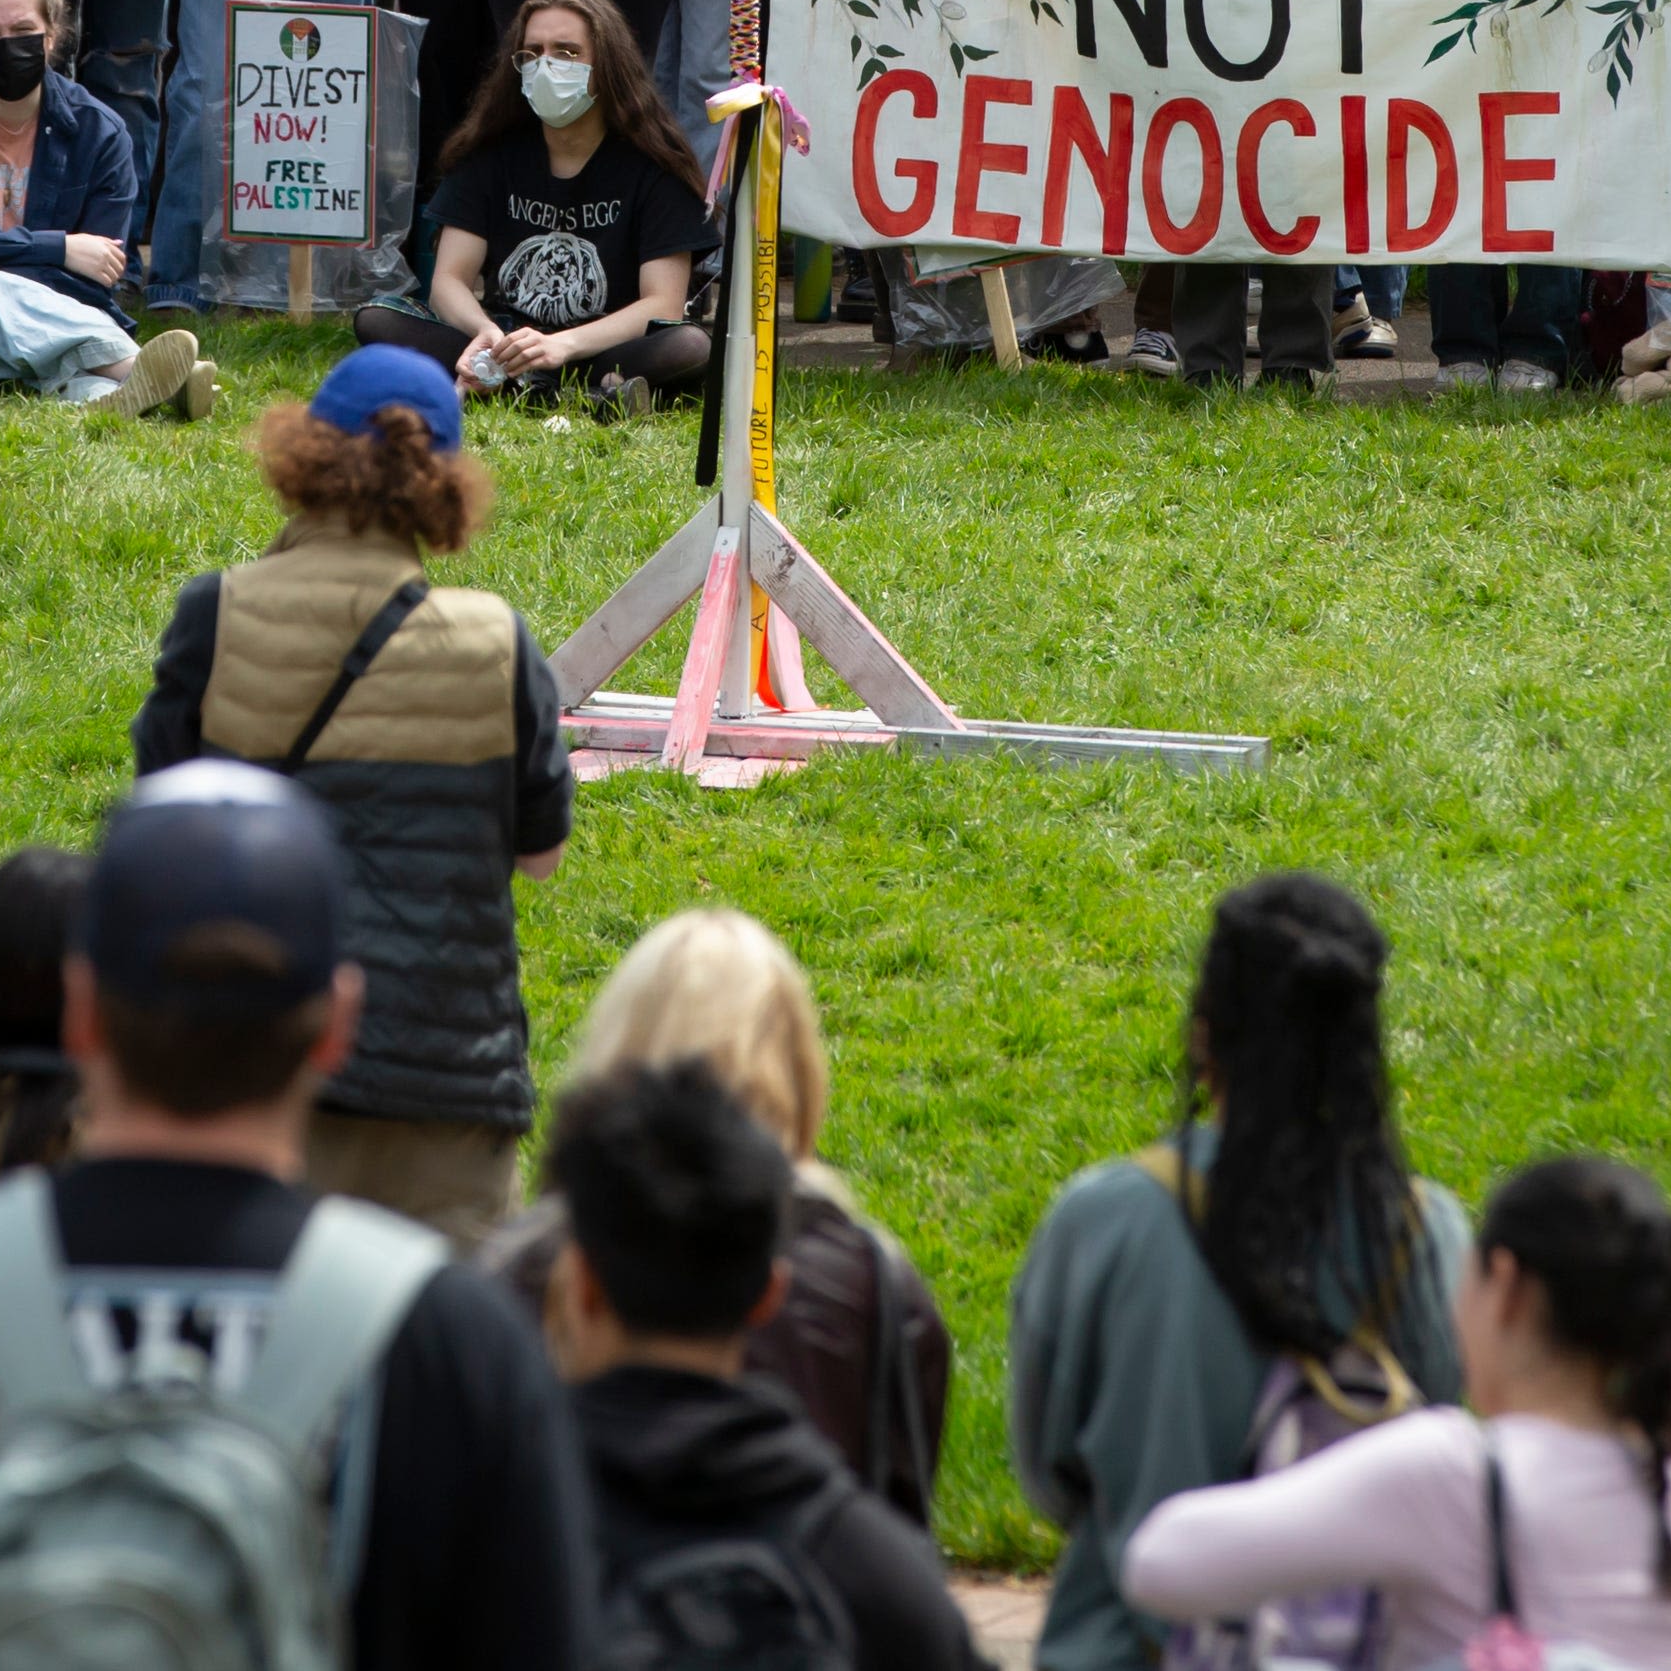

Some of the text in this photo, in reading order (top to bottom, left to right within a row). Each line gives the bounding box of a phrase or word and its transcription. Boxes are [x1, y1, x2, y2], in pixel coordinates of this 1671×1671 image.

[236, 62, 366, 109] DIVEST
[253, 112, 328, 145] NOW!
[265, 159, 328, 185] FREE
[851, 69, 1562, 258] GENOCIDE
[233, 181, 362, 211] PALESTINE
[507, 194, 578, 232] ANGEL'S
[755, 348, 771, 375] IS
[750, 401, 771, 485] FUTURE
